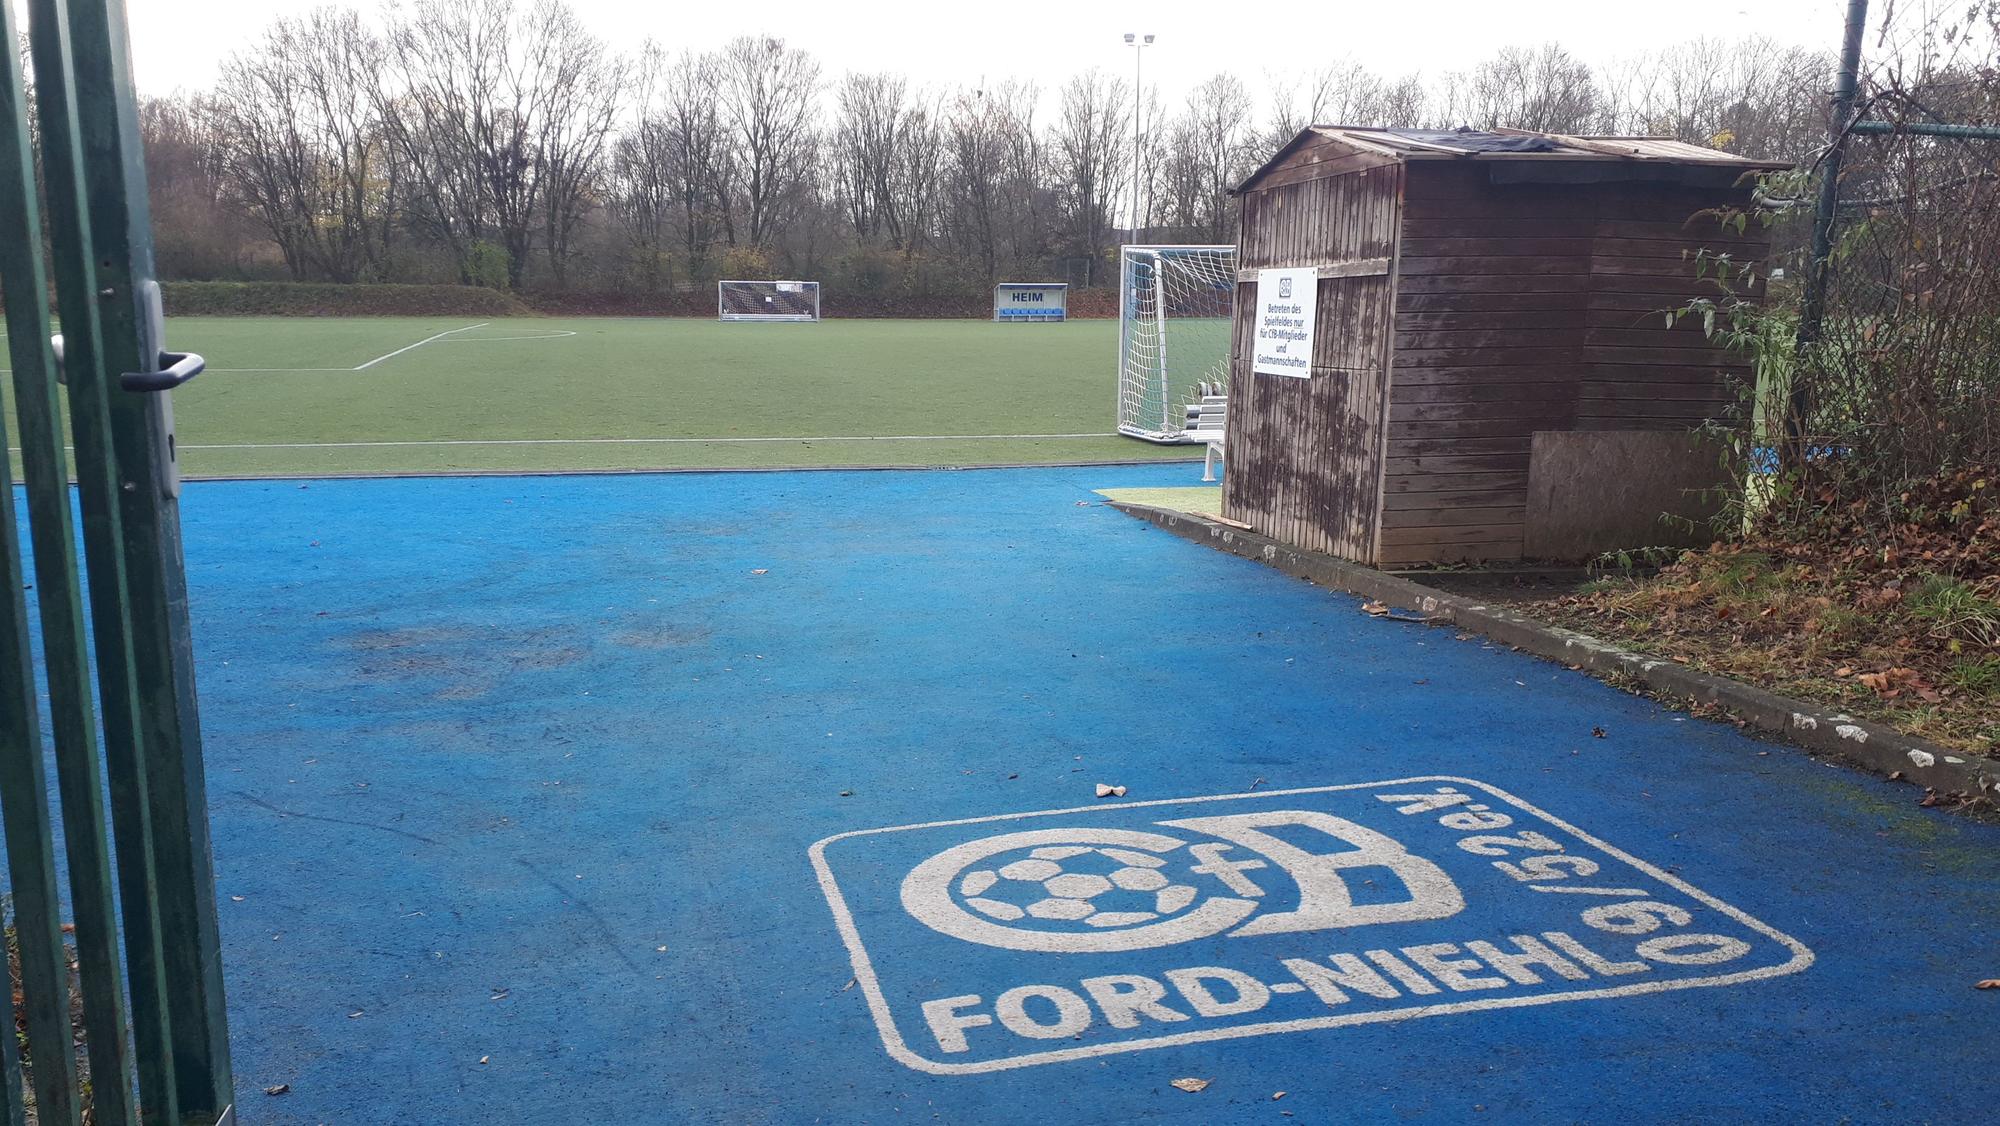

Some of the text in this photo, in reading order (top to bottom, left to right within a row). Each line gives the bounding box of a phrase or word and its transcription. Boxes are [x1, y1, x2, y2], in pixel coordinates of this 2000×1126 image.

[1012, 292, 1043, 302] HEIM
[1268, 303, 1301, 313] Betreten des
[1264, 316, 1304, 328] Spielfeldes nur
[1260, 328, 1308, 342] für CfB-Mitglieder
[1276, 343, 1287, 353] und
[1257, 354, 1307, 368] Gastmannschaften
[900, 810, 1465, 953] CfB
[921, 931, 1652, 1054] FORD-NIEHL
